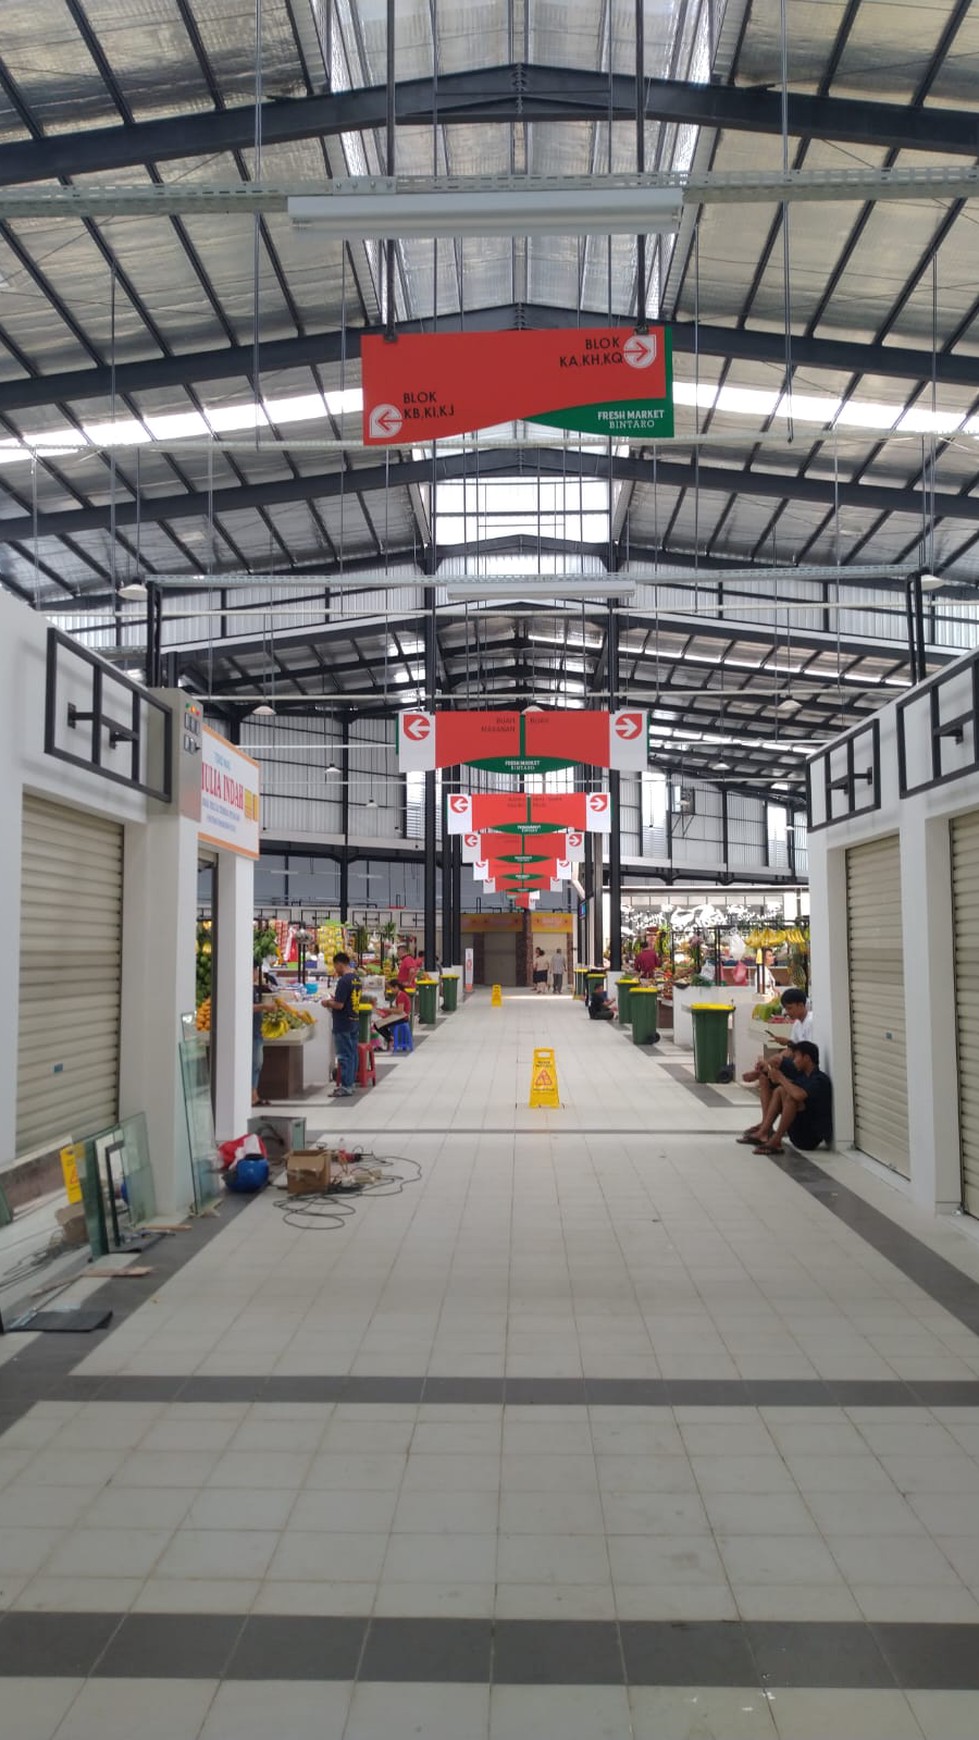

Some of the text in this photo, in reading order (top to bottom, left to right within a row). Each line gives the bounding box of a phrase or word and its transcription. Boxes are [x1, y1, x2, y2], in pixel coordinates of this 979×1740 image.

[585, 337, 620, 350] BLOK
[403, 391, 437, 404] BLOK
[597, 409, 665, 421] FRESH MARKET
[609, 419, 655, 429] BINTARO
